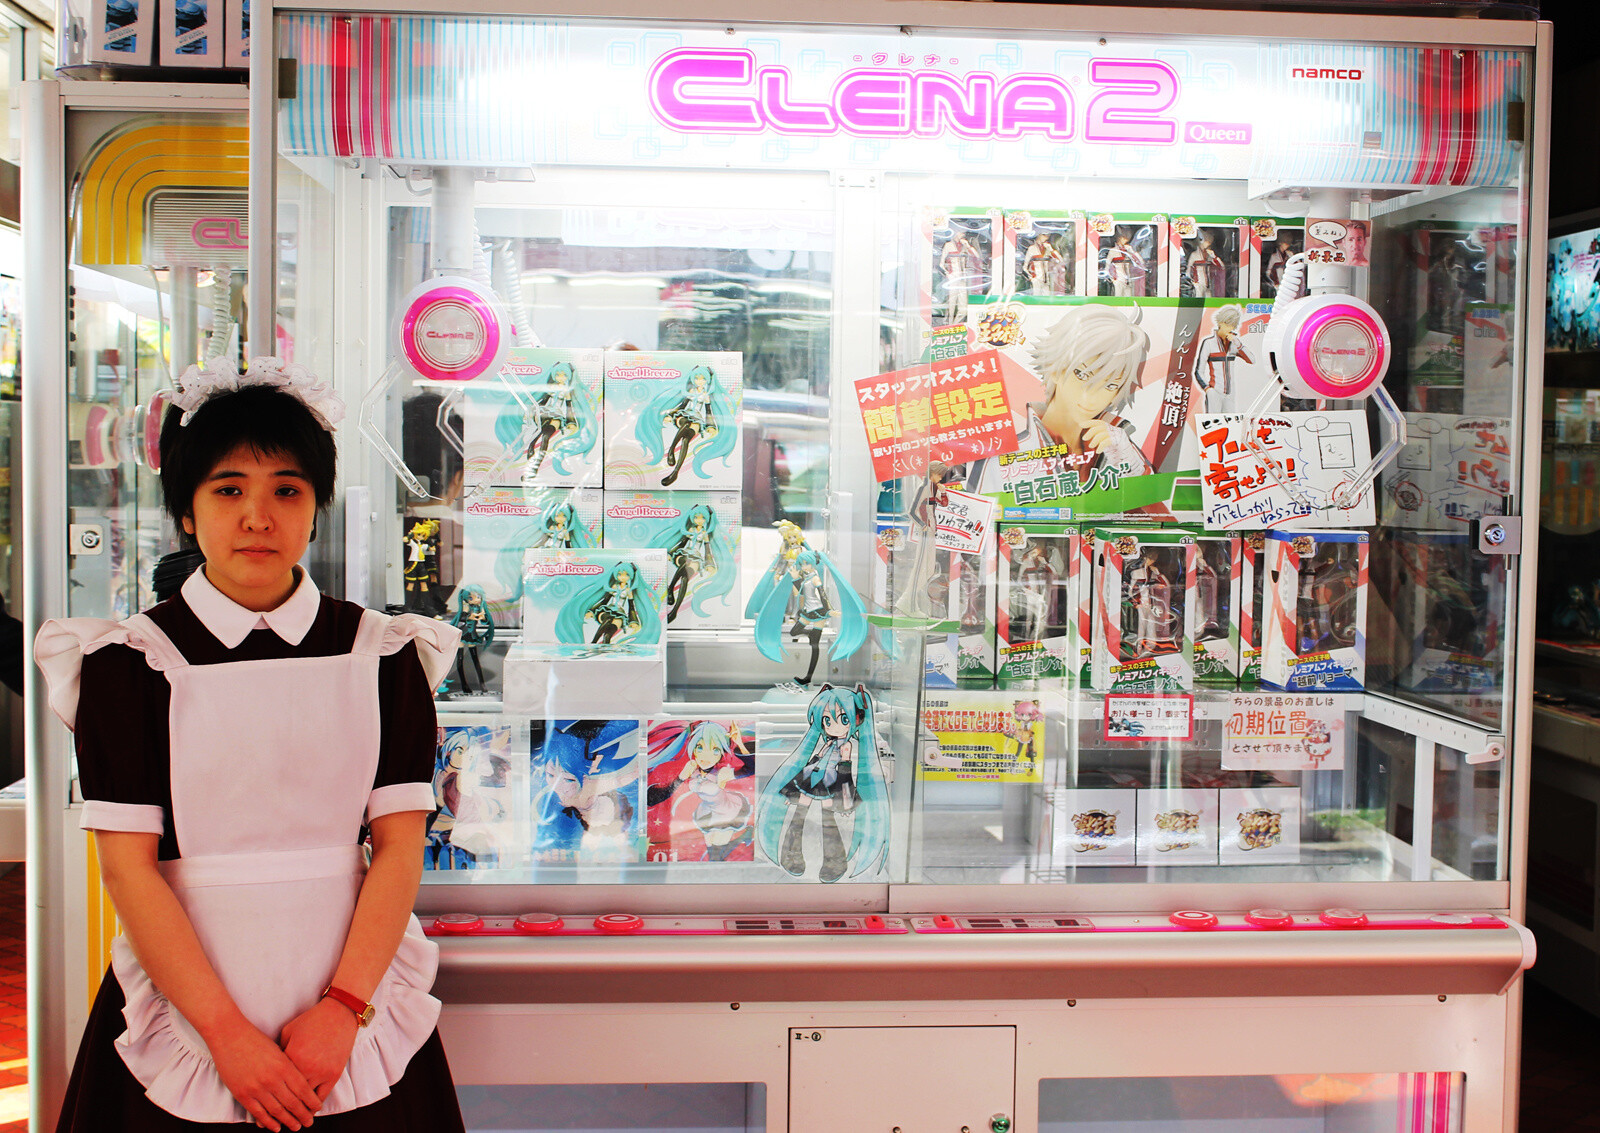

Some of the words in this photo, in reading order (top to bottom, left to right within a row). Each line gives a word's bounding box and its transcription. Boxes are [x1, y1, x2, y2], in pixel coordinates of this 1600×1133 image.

[1292, 68, 1362, 80] namco
[1190, 124, 1246, 142] Queen
[1308, 250, 1345, 263] 新景品
[1249, 320, 1266, 333] 全1
[859, 357, 998, 403] スタッフオススメ！
[863, 382, 1008, 444] 簡単設定
[1180, 386, 1191, 428] エクスタシー
[999, 444, 1068, 466] 新テニスの王子様
[1000, 450, 1095, 479] プレミアムフィギュア
[1234, 696, 1334, 707] ちらの景品のお直しは
[1225, 710, 1307, 735] 初期位置
